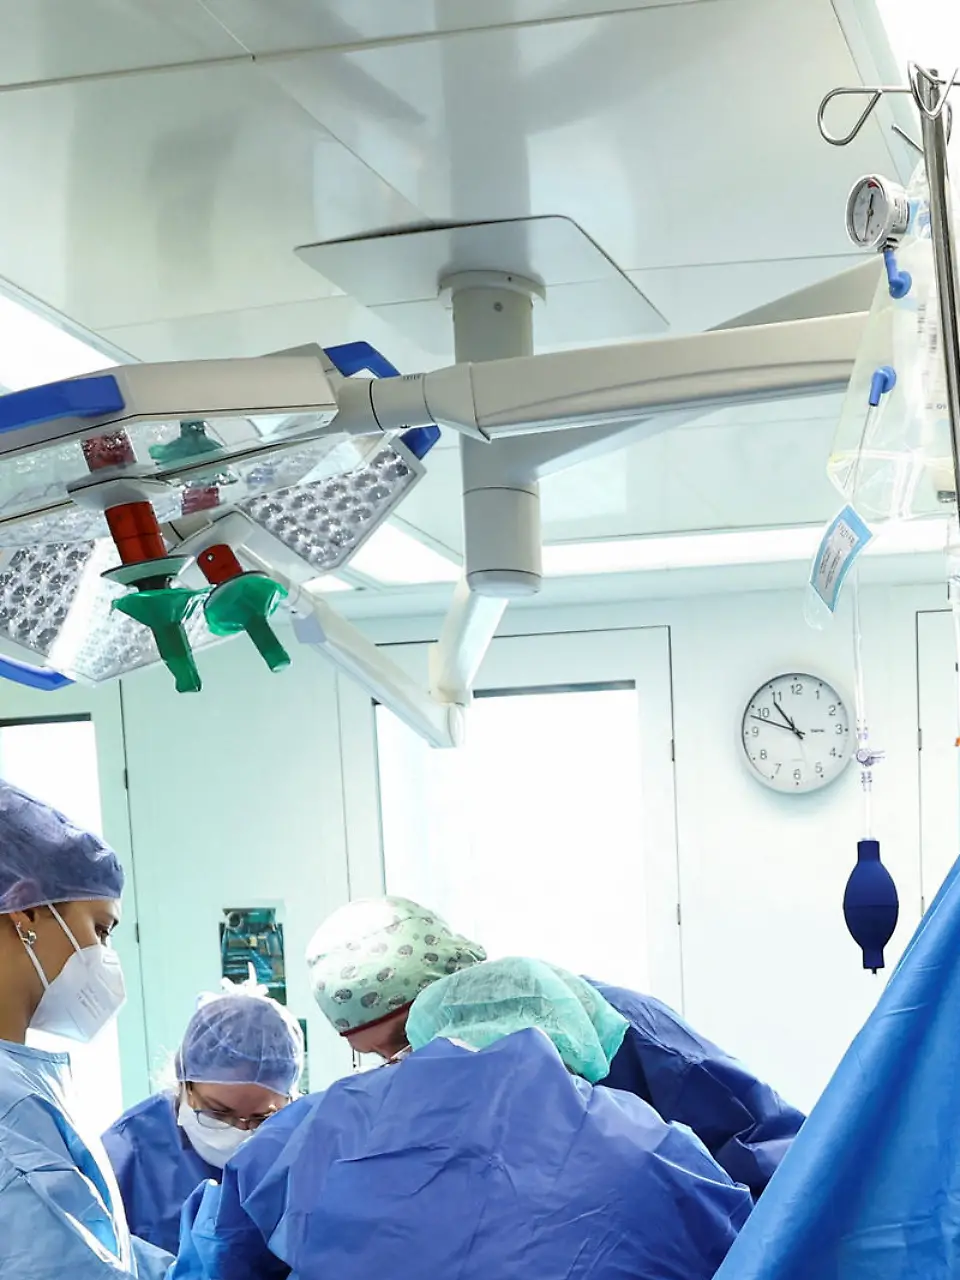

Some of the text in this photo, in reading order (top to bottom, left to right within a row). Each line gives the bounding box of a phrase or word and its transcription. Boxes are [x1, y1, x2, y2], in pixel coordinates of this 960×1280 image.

[790, 683, 804, 696] 12
[815, 689, 820, 700] 1
[772, 691, 782, 702] 11
[757, 708, 770, 718] 10
[828, 704, 836, 716] 2
[751, 726, 759, 738] 9
[835, 723, 843, 735] 3
[760, 749, 768, 760] 8
[829, 747, 837, 758] 4
[774, 763, 782, 775] 7
[815, 762, 823, 774] 5
[793, 768, 802, 781] 6
